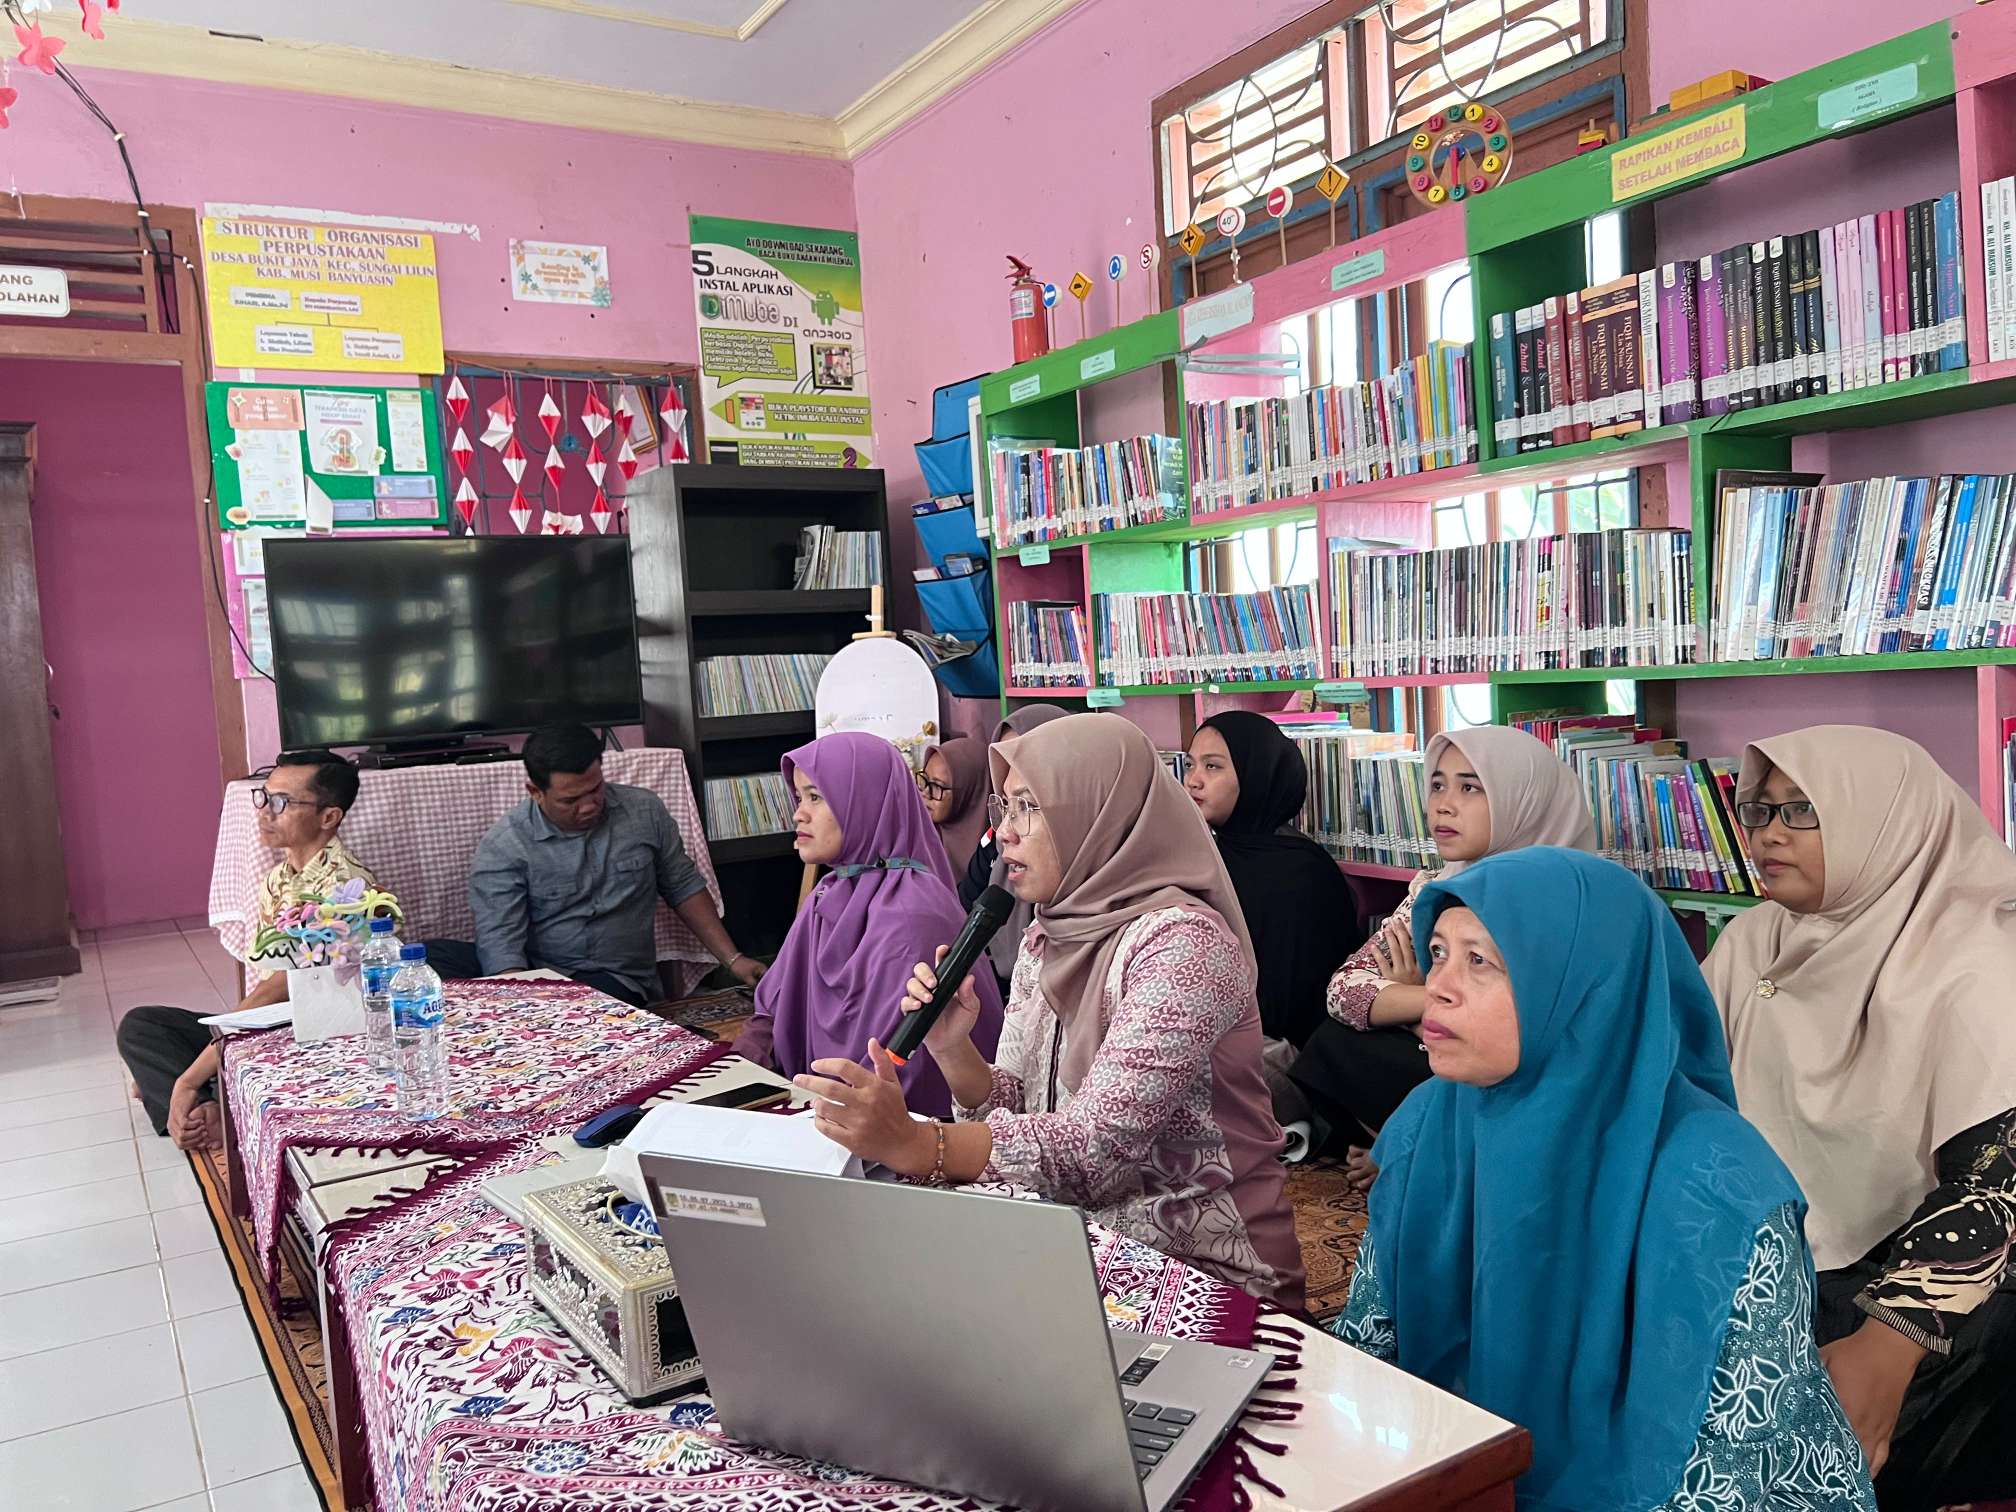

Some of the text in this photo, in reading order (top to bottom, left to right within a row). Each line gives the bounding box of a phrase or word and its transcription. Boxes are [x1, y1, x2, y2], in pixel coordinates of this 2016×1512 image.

[1470, 108, 1476, 116] 1
[1429, 118, 1439, 128] 11
[1484, 118, 1493, 129] 2
[1414, 135, 1427, 147] 10
[1493, 137, 1500, 145] 3
[1618, 117, 1734, 171] RAPIKAN KEMBALI
[1411, 158, 1418, 166] 9
[1487, 158, 1494, 167] 4
[1617, 137, 1740, 191] SETELAH MEMBACA
[1432, 189, 1440, 198] 7
[222, 221, 420, 248] STRUKTUR ORGANISASI
[263, 240, 385, 261] PERPUSTAKAAN
[746, 237, 845, 256] AYO DOWNLOAD SEKARANG
[211, 251, 435, 277] DESA BUKIT JAYA KEC. SUNGAI LILIN
[691, 249, 779, 280] 5 LANGKAH
[256, 267, 394, 286] KAB. MUSI BANYUASIN
[699, 278, 794, 297] INSTAL APLIKASI
[783, 316, 799, 328] DI
[1520, 342, 1529, 374] Zuhud
[1536, 338, 1545, 370] Zuhud
[1625, 342, 1634, 385] SUNNAH
[1598, 348, 1609, 391] SUNNAH
[842, 447, 858, 469] 2
